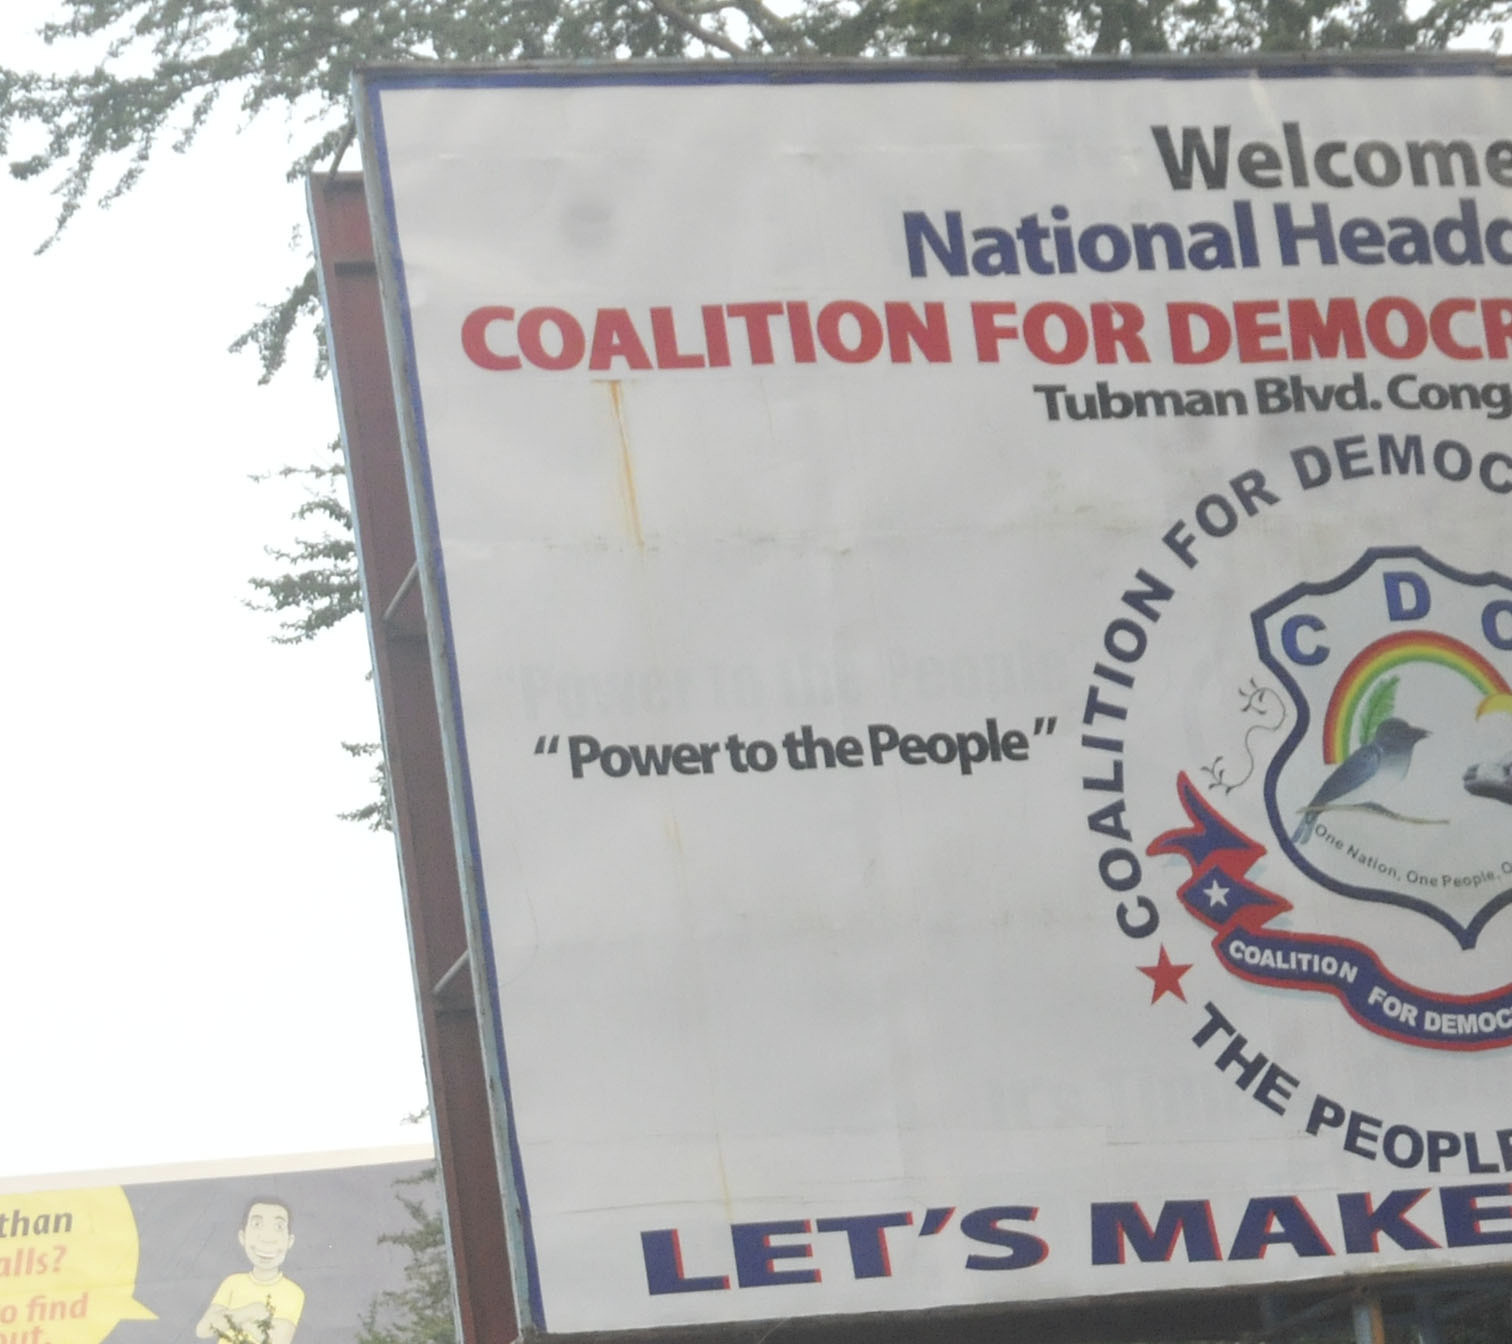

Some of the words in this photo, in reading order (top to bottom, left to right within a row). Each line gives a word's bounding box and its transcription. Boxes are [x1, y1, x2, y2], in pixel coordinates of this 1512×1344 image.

[903, 200, 1261, 277] National
[460, 300, 952, 371] COALITION
[971, 300, 1150, 365] FOR
[1033, 383, 1247, 422] Tubman
[1253, 375, 1381, 416] Blvd.
[1081, 569, 1175, 939] COALITION
[1163, 467, 1281, 569] FOR
[726, 733, 778, 772] to
[782, 724, 864, 770] the
[1315, 824, 1343, 850] One
[1406, 870, 1437, 887] One
[1228, 939, 1358, 984] COALITION
[1368, 986, 1417, 1028] FOR
[1190, 1001, 1302, 1116] THE
[27, 1291, 90, 1322] find
